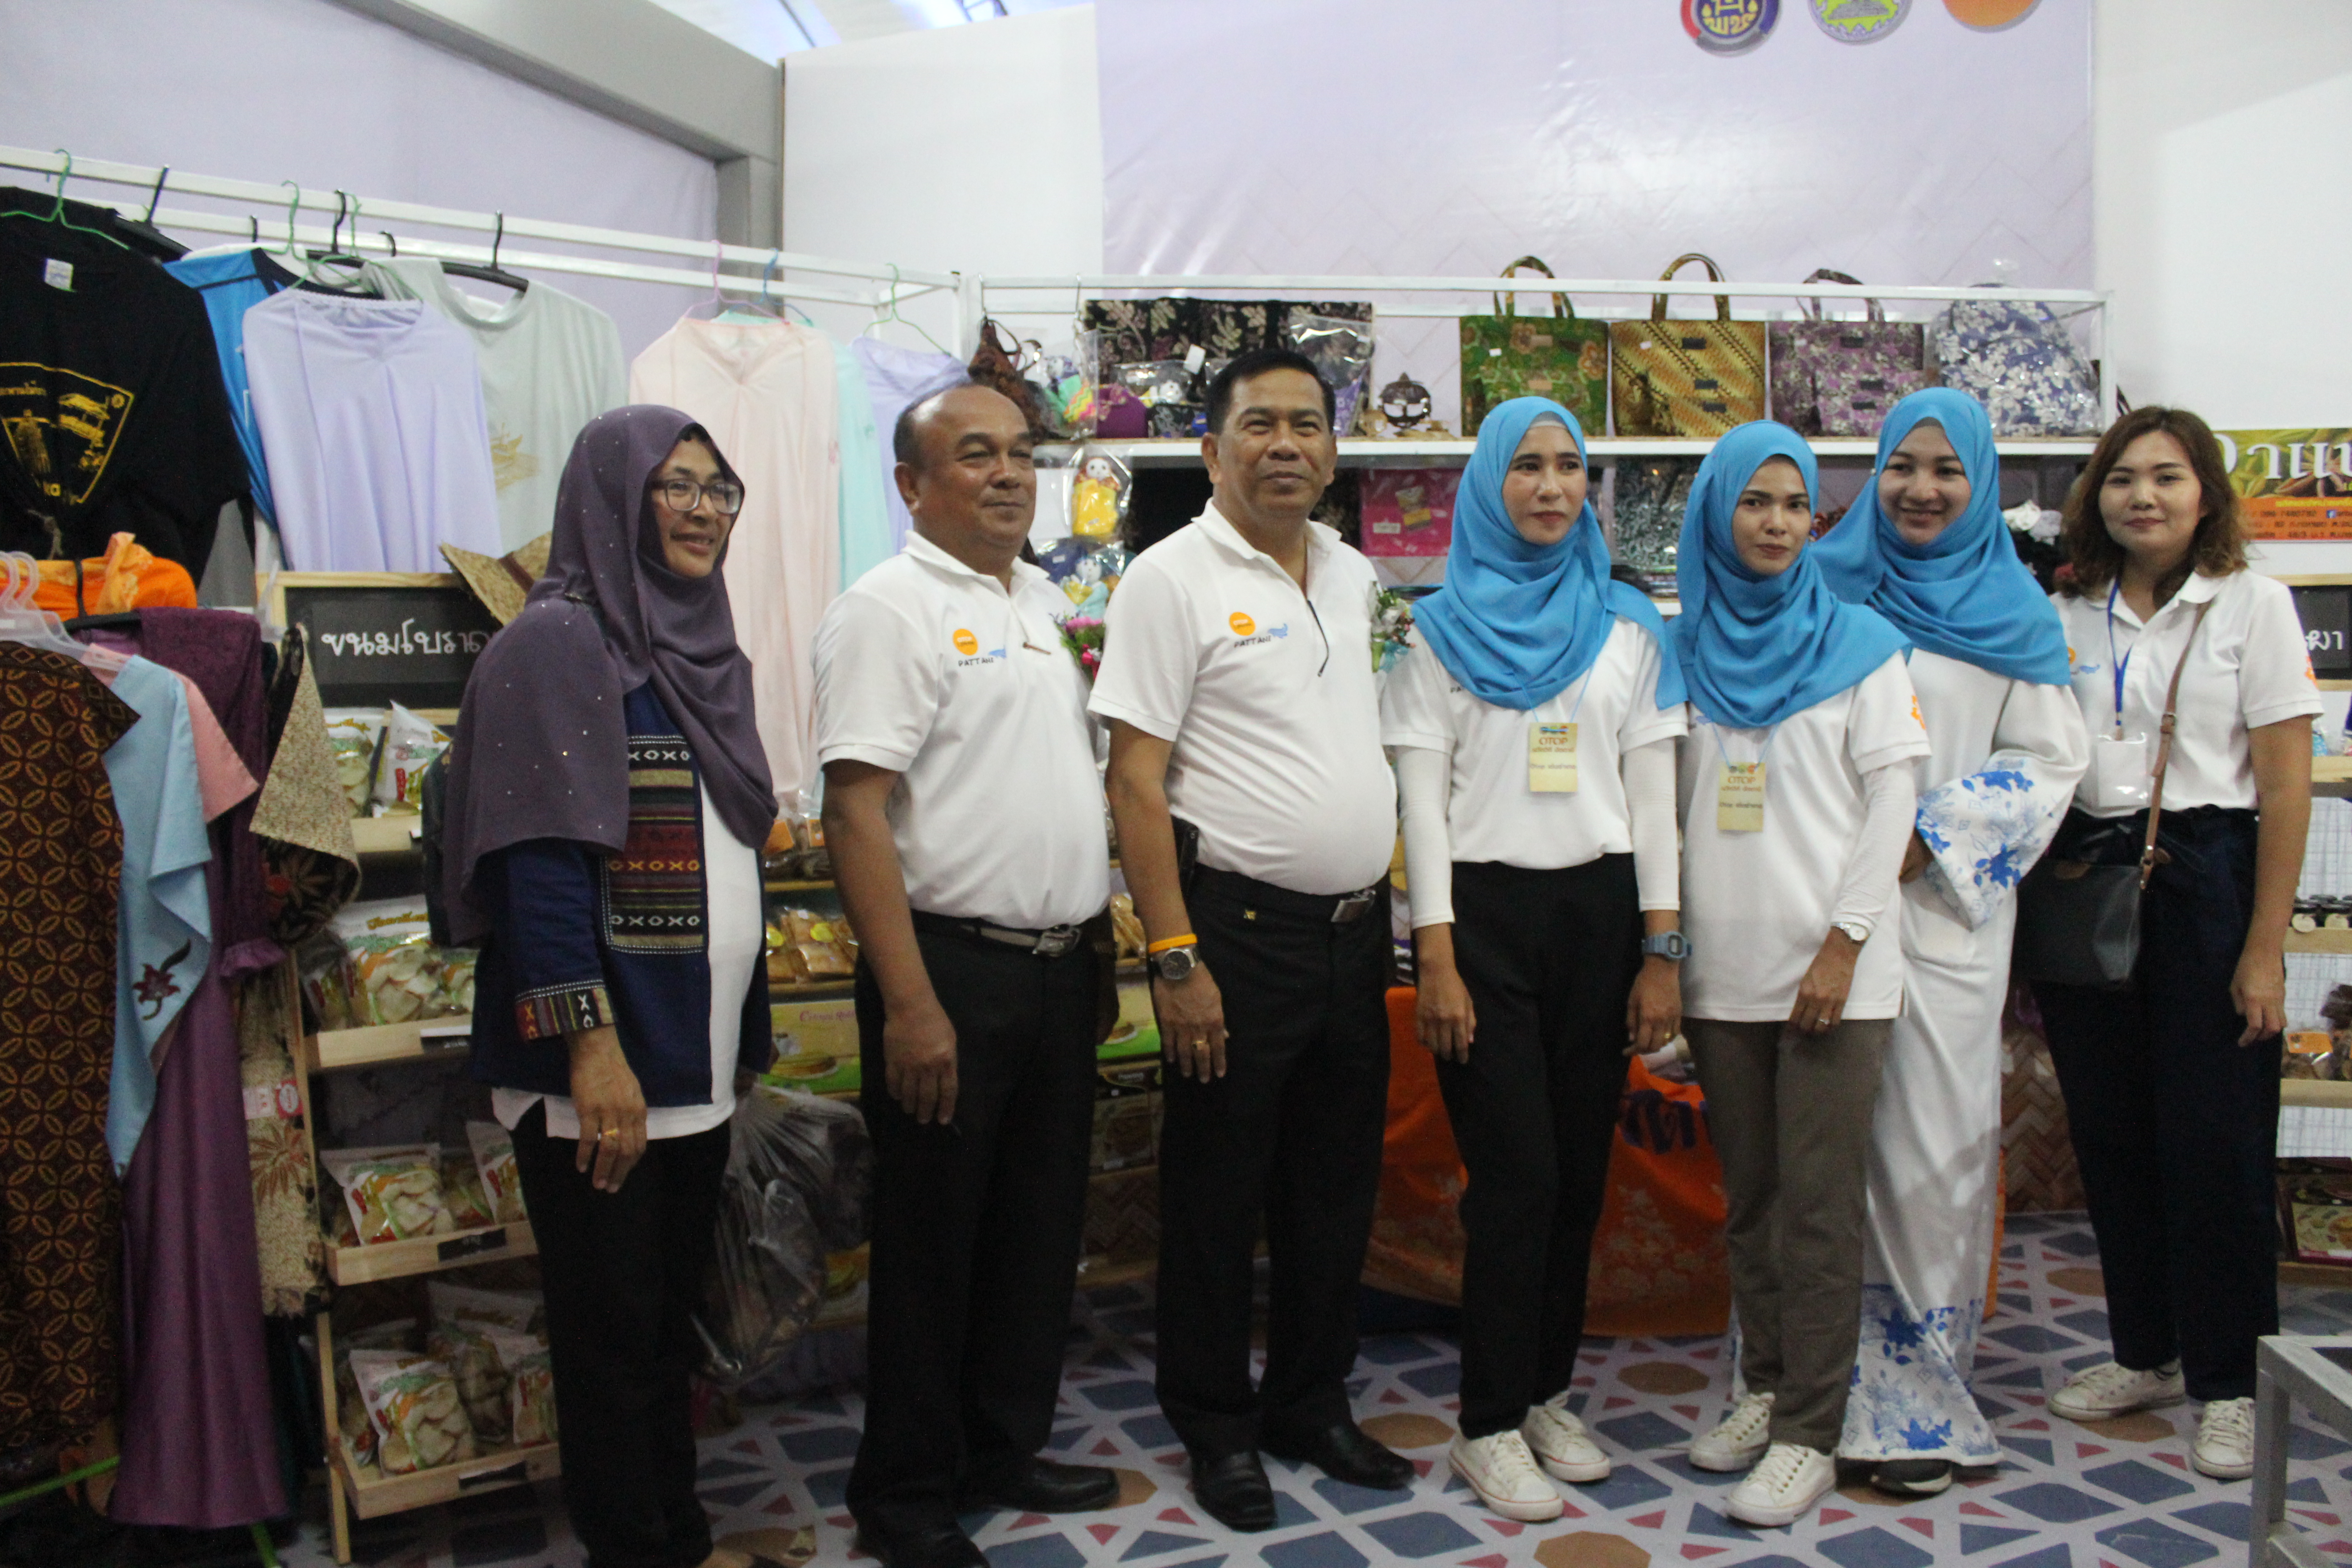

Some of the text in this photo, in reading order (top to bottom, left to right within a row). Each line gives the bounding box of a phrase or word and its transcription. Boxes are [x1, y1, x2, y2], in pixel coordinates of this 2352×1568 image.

[1234, 635, 1271, 648] PATTANI
[958, 657, 994, 667] PATTANI
[1539, 737, 1568, 745] OTOP
[1727, 776, 1756, 784] OTOP
